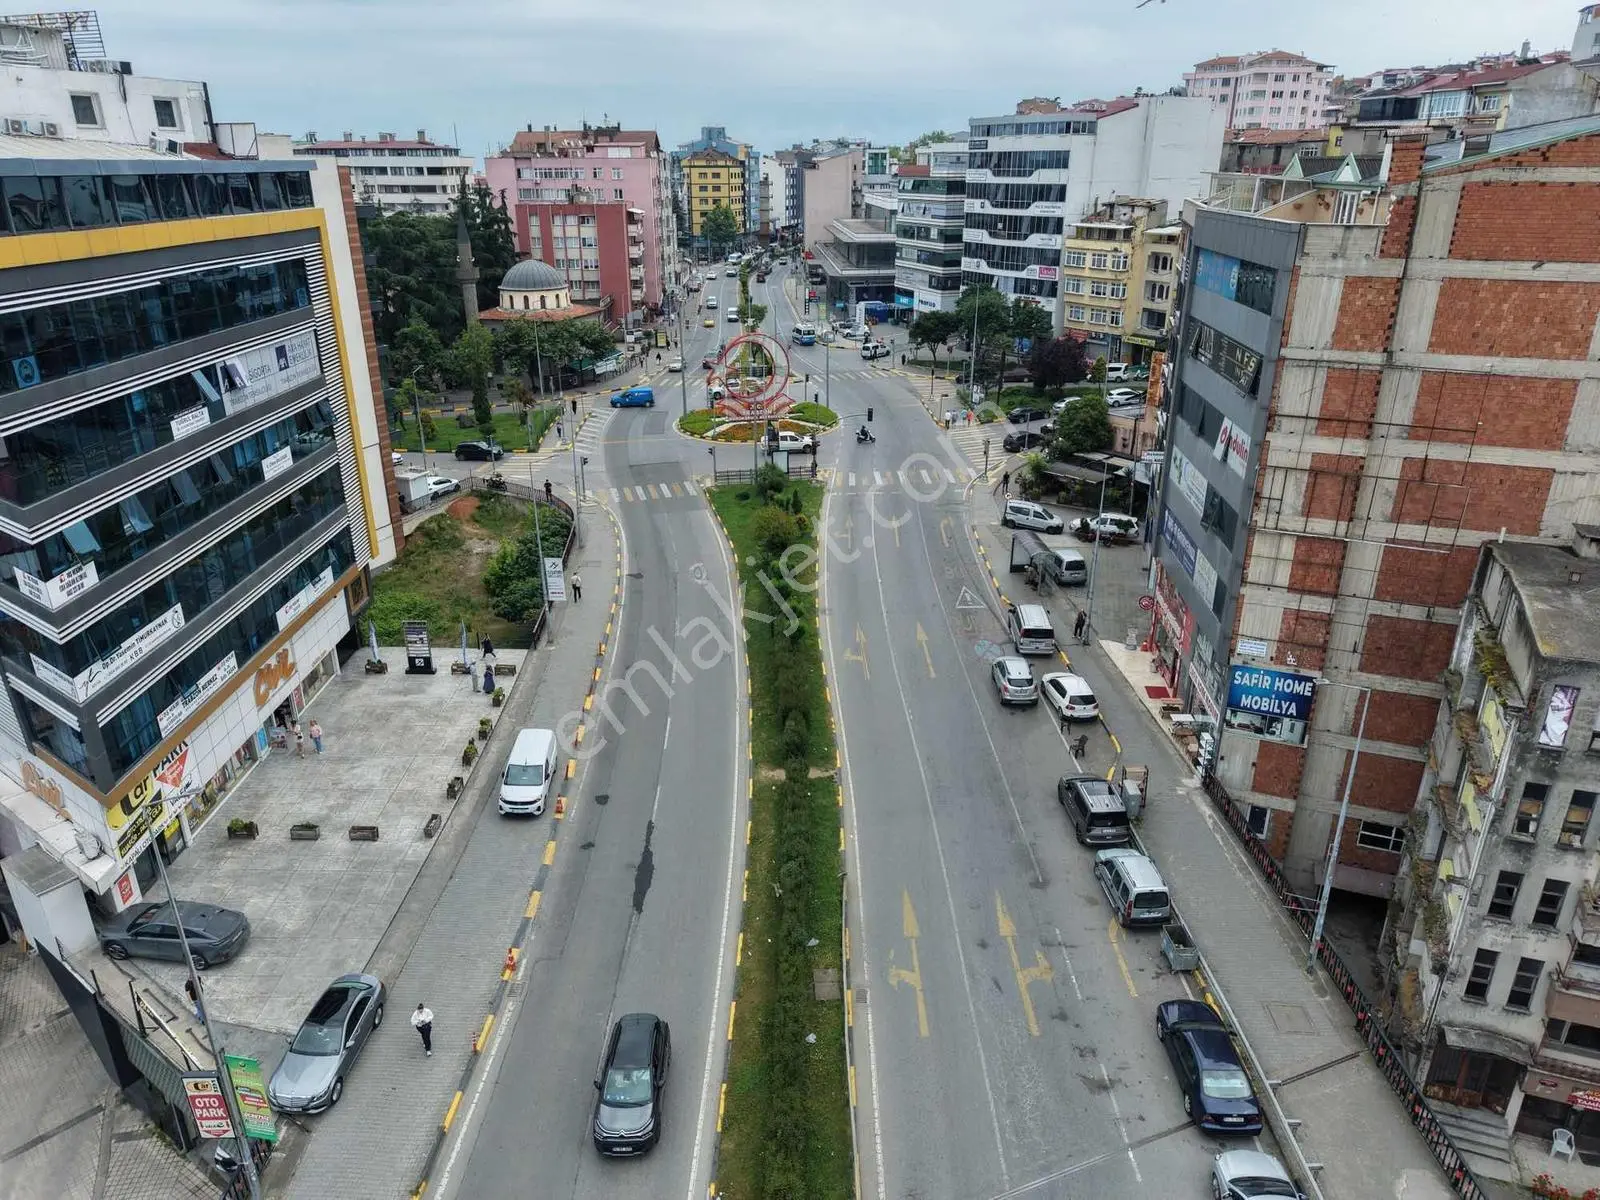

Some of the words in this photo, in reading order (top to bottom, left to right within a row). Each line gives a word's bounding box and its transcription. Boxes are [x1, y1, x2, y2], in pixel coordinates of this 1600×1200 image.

[1233, 670, 1272, 690] SAFİR
[1274, 676, 1314, 697] HOME
[1240, 694, 1297, 717] MOBİLYA
[195, 1097, 219, 1107] OTO
[194, 1108, 226, 1118] PARK
